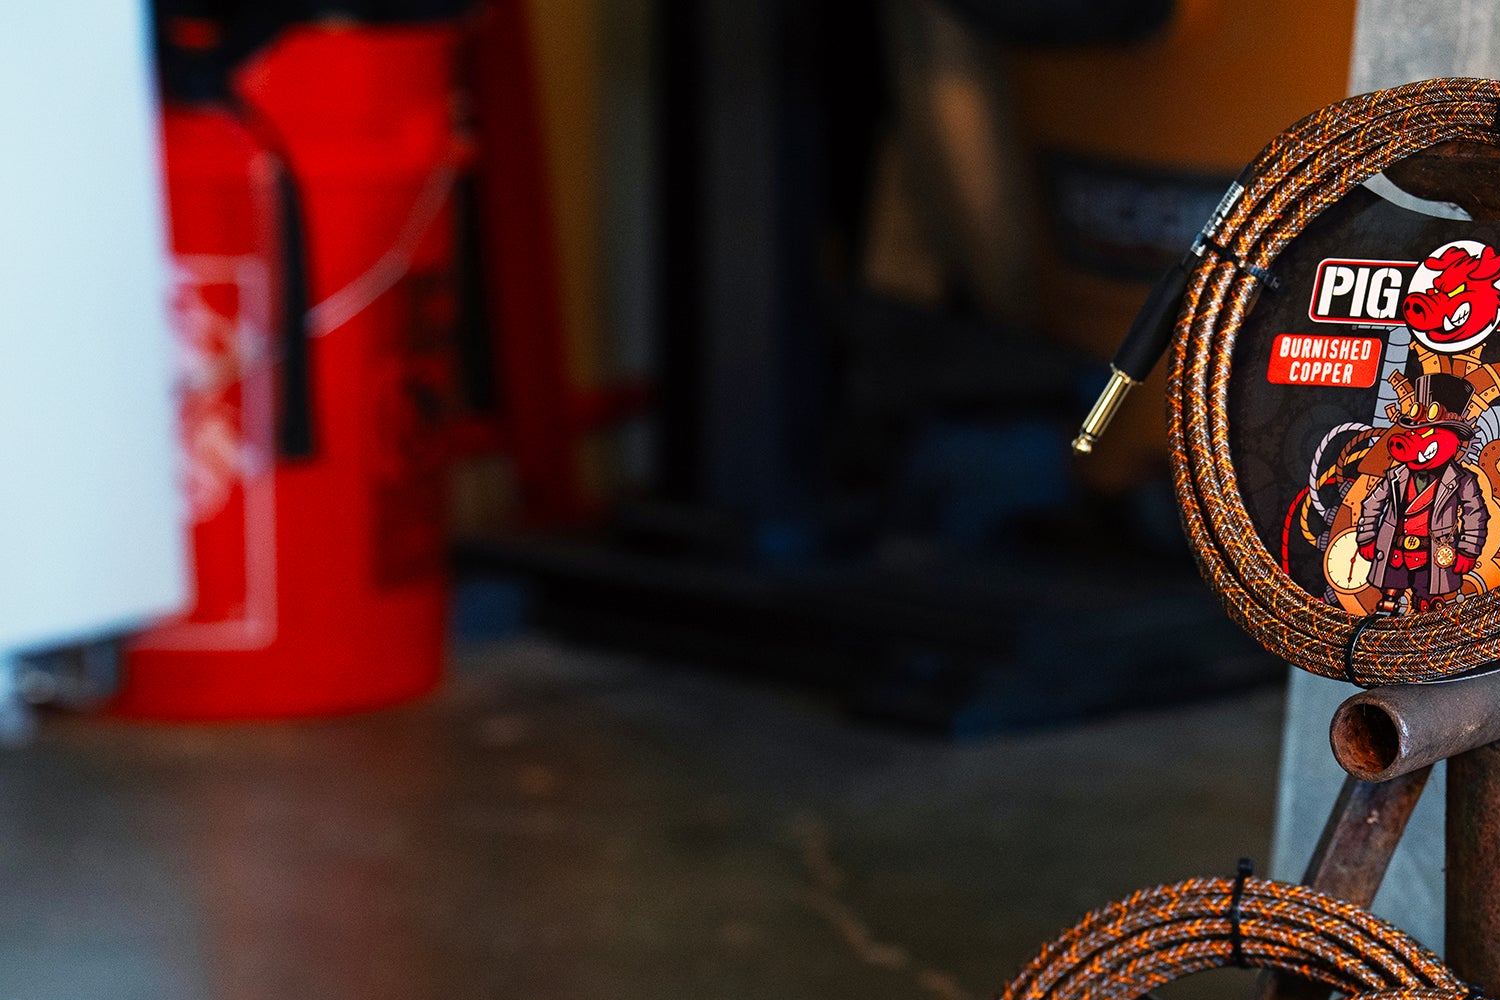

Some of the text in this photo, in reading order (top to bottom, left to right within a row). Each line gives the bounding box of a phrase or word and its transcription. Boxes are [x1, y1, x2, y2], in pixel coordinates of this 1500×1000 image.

[1316, 265, 1404, 320] PIG
[1279, 336, 1373, 361] BURNISHED
[1289, 361, 1354, 385] COPPER
